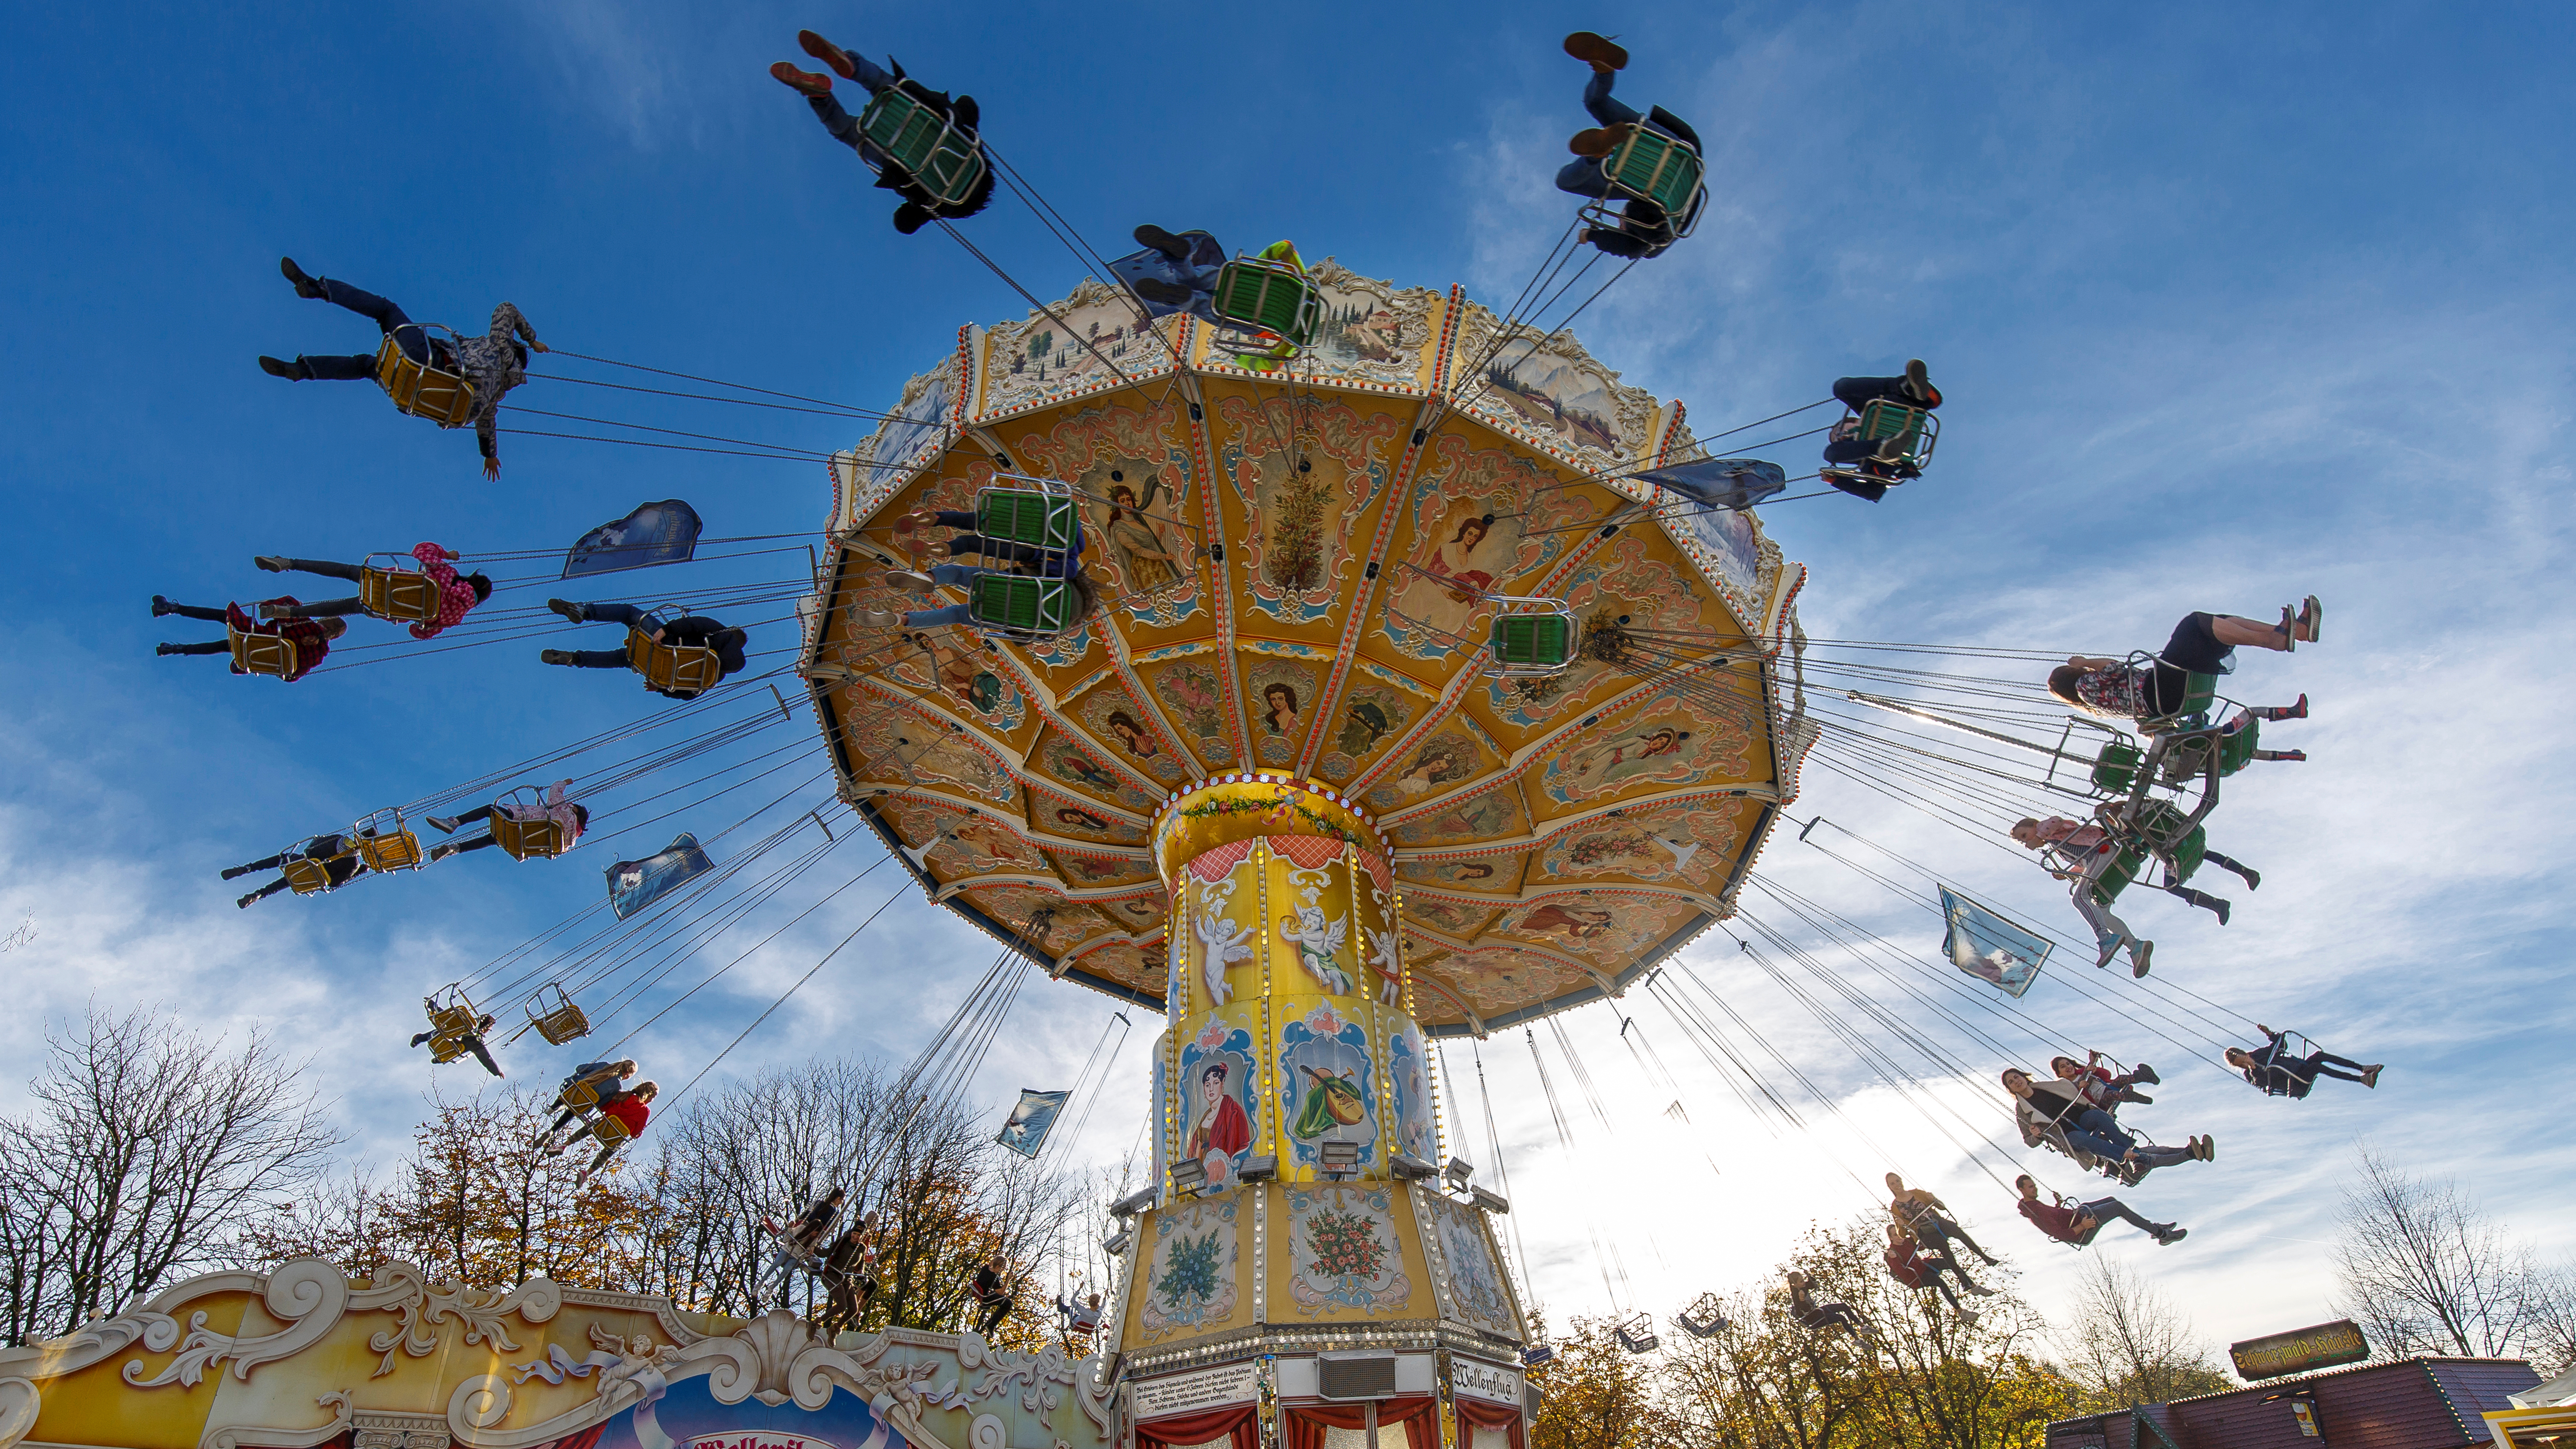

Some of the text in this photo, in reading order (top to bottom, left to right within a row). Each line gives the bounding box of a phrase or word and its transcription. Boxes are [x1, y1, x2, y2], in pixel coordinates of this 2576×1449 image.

[2234, 1328, 2362, 1369] Schwarzwald-Häusle
[1236, 1368, 1251, 1377] Podium
[1452, 1359, 1518, 1401] Wellenflug
[1180, 1398, 1209, 1407] mitgenommen
